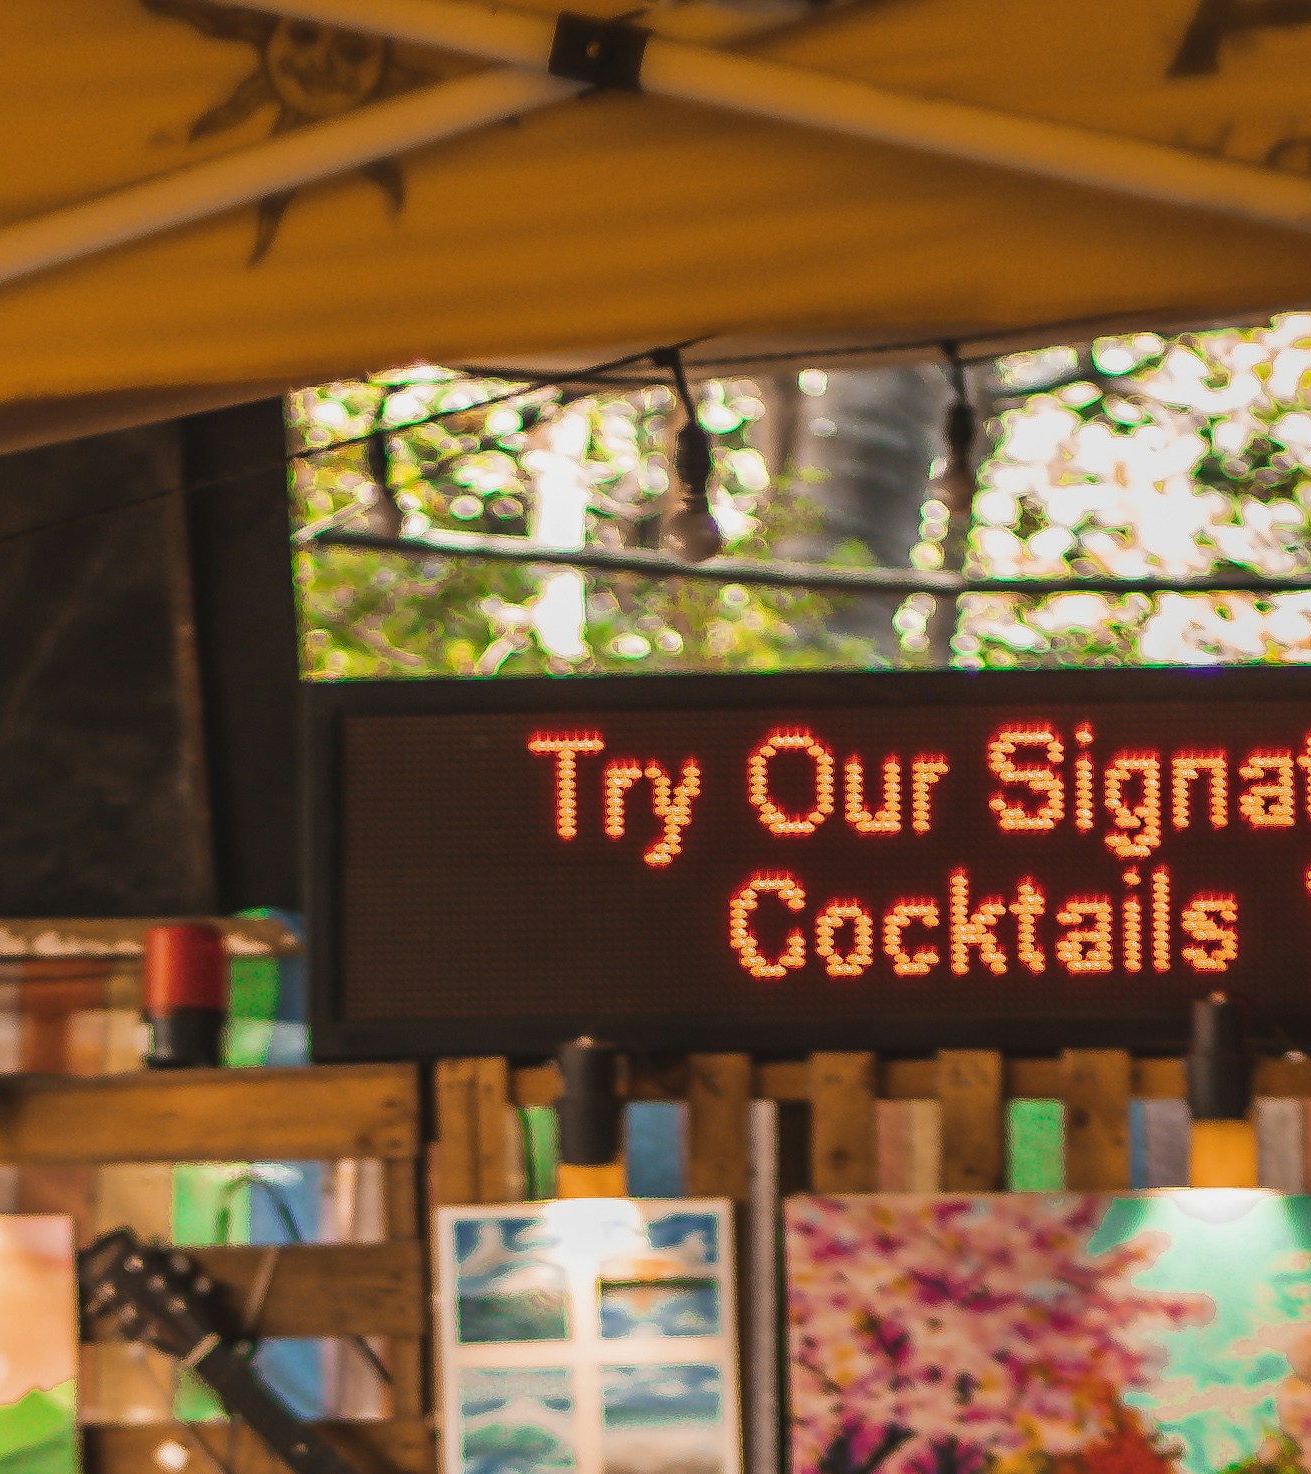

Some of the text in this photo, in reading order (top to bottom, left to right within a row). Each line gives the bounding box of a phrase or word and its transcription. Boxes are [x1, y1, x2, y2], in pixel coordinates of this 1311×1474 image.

[527, 730, 701, 864] Try
[747, 727, 951, 836] Our
[729, 866, 1239, 977] Cocktails
